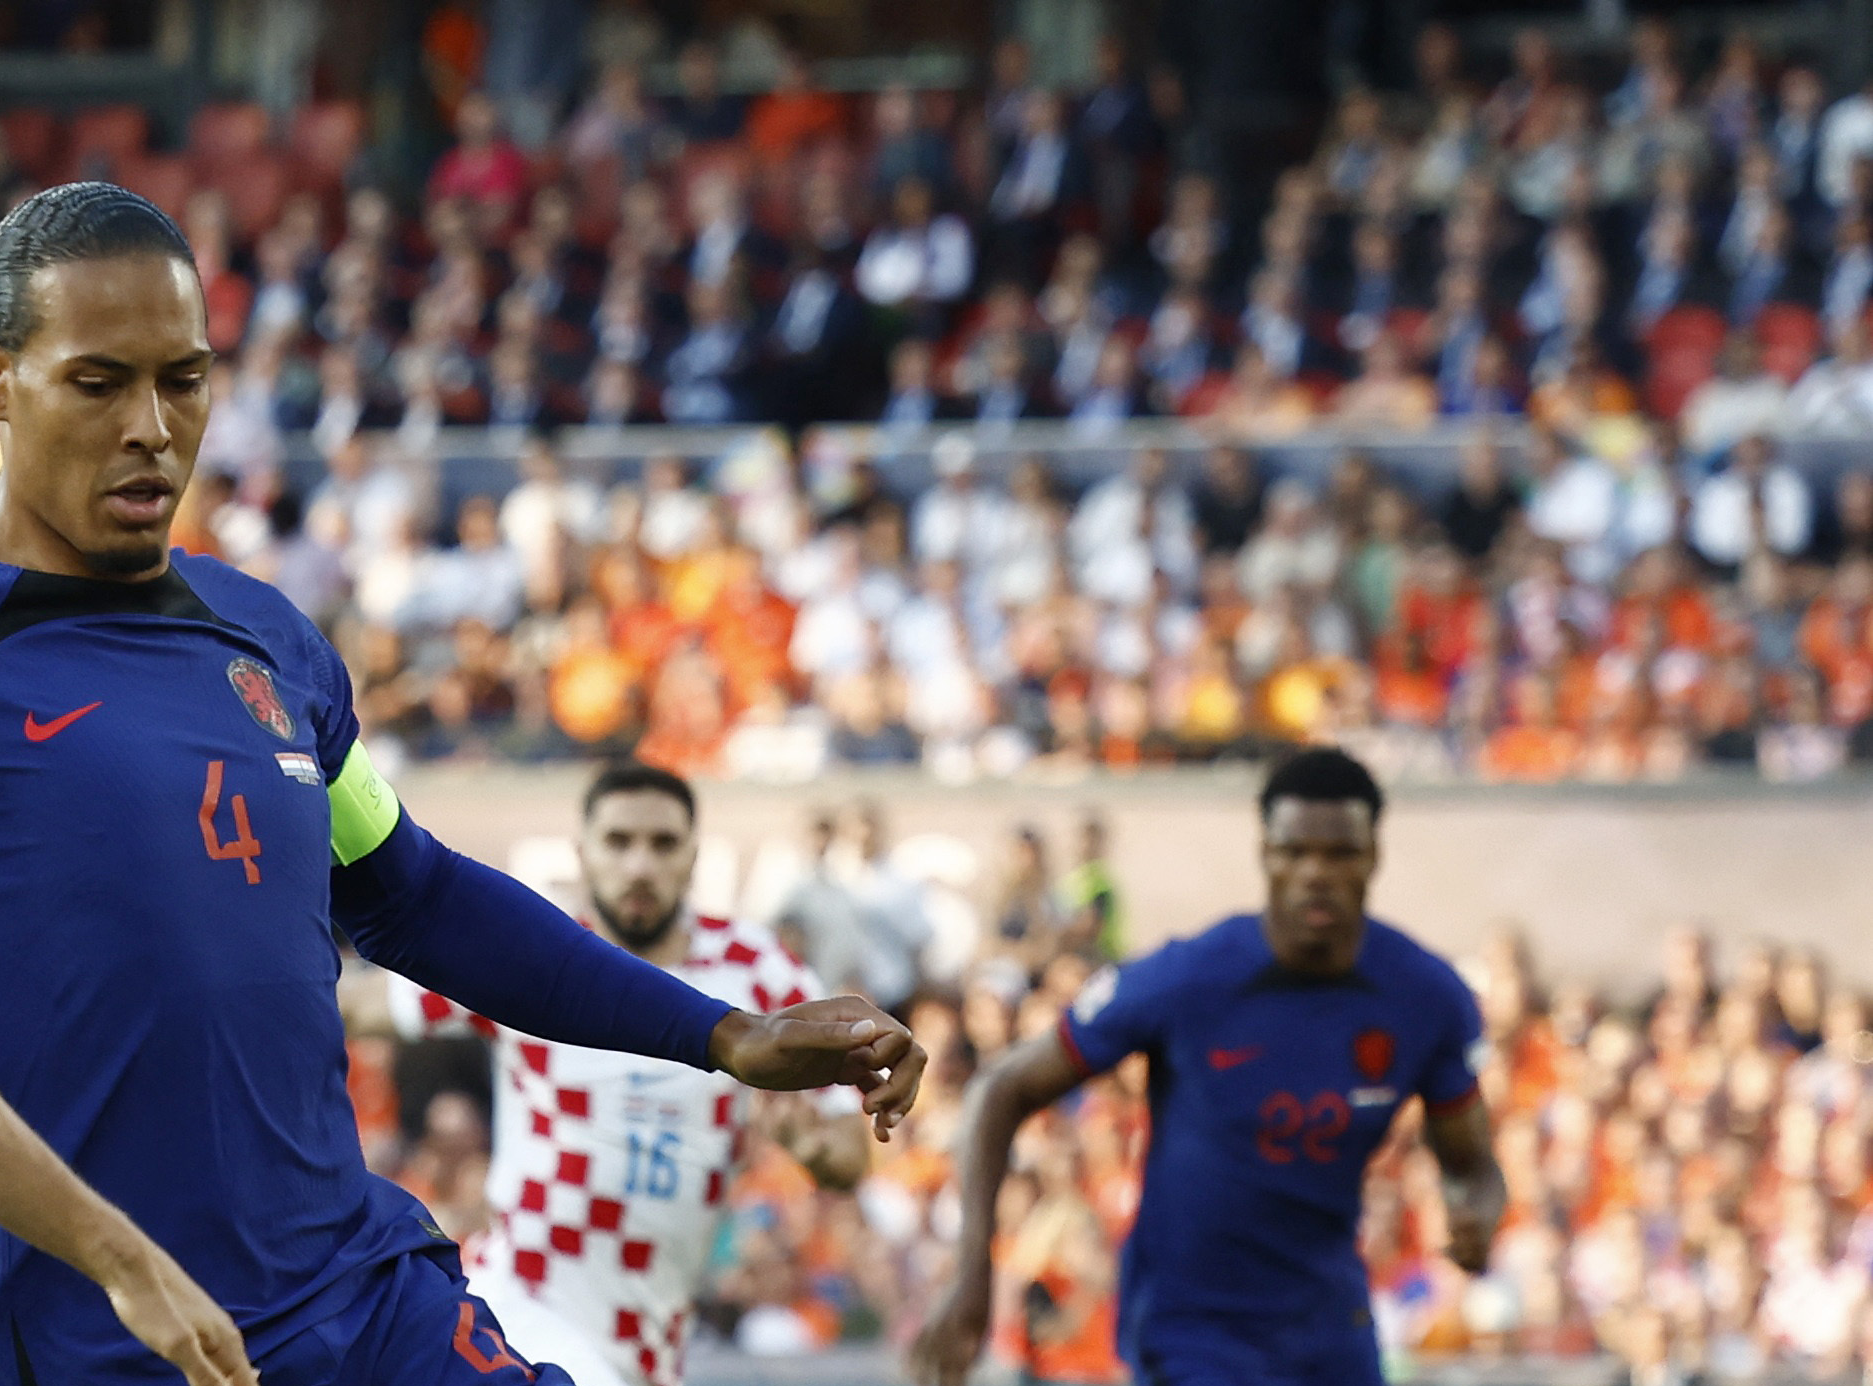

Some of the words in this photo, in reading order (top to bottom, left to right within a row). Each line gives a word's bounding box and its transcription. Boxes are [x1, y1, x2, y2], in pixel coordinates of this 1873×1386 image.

[198, 760, 261, 884] 4
[624, 1130, 682, 1199] 16
[1256, 1089, 1352, 1164] 22
[452, 1301, 538, 1384] 4
